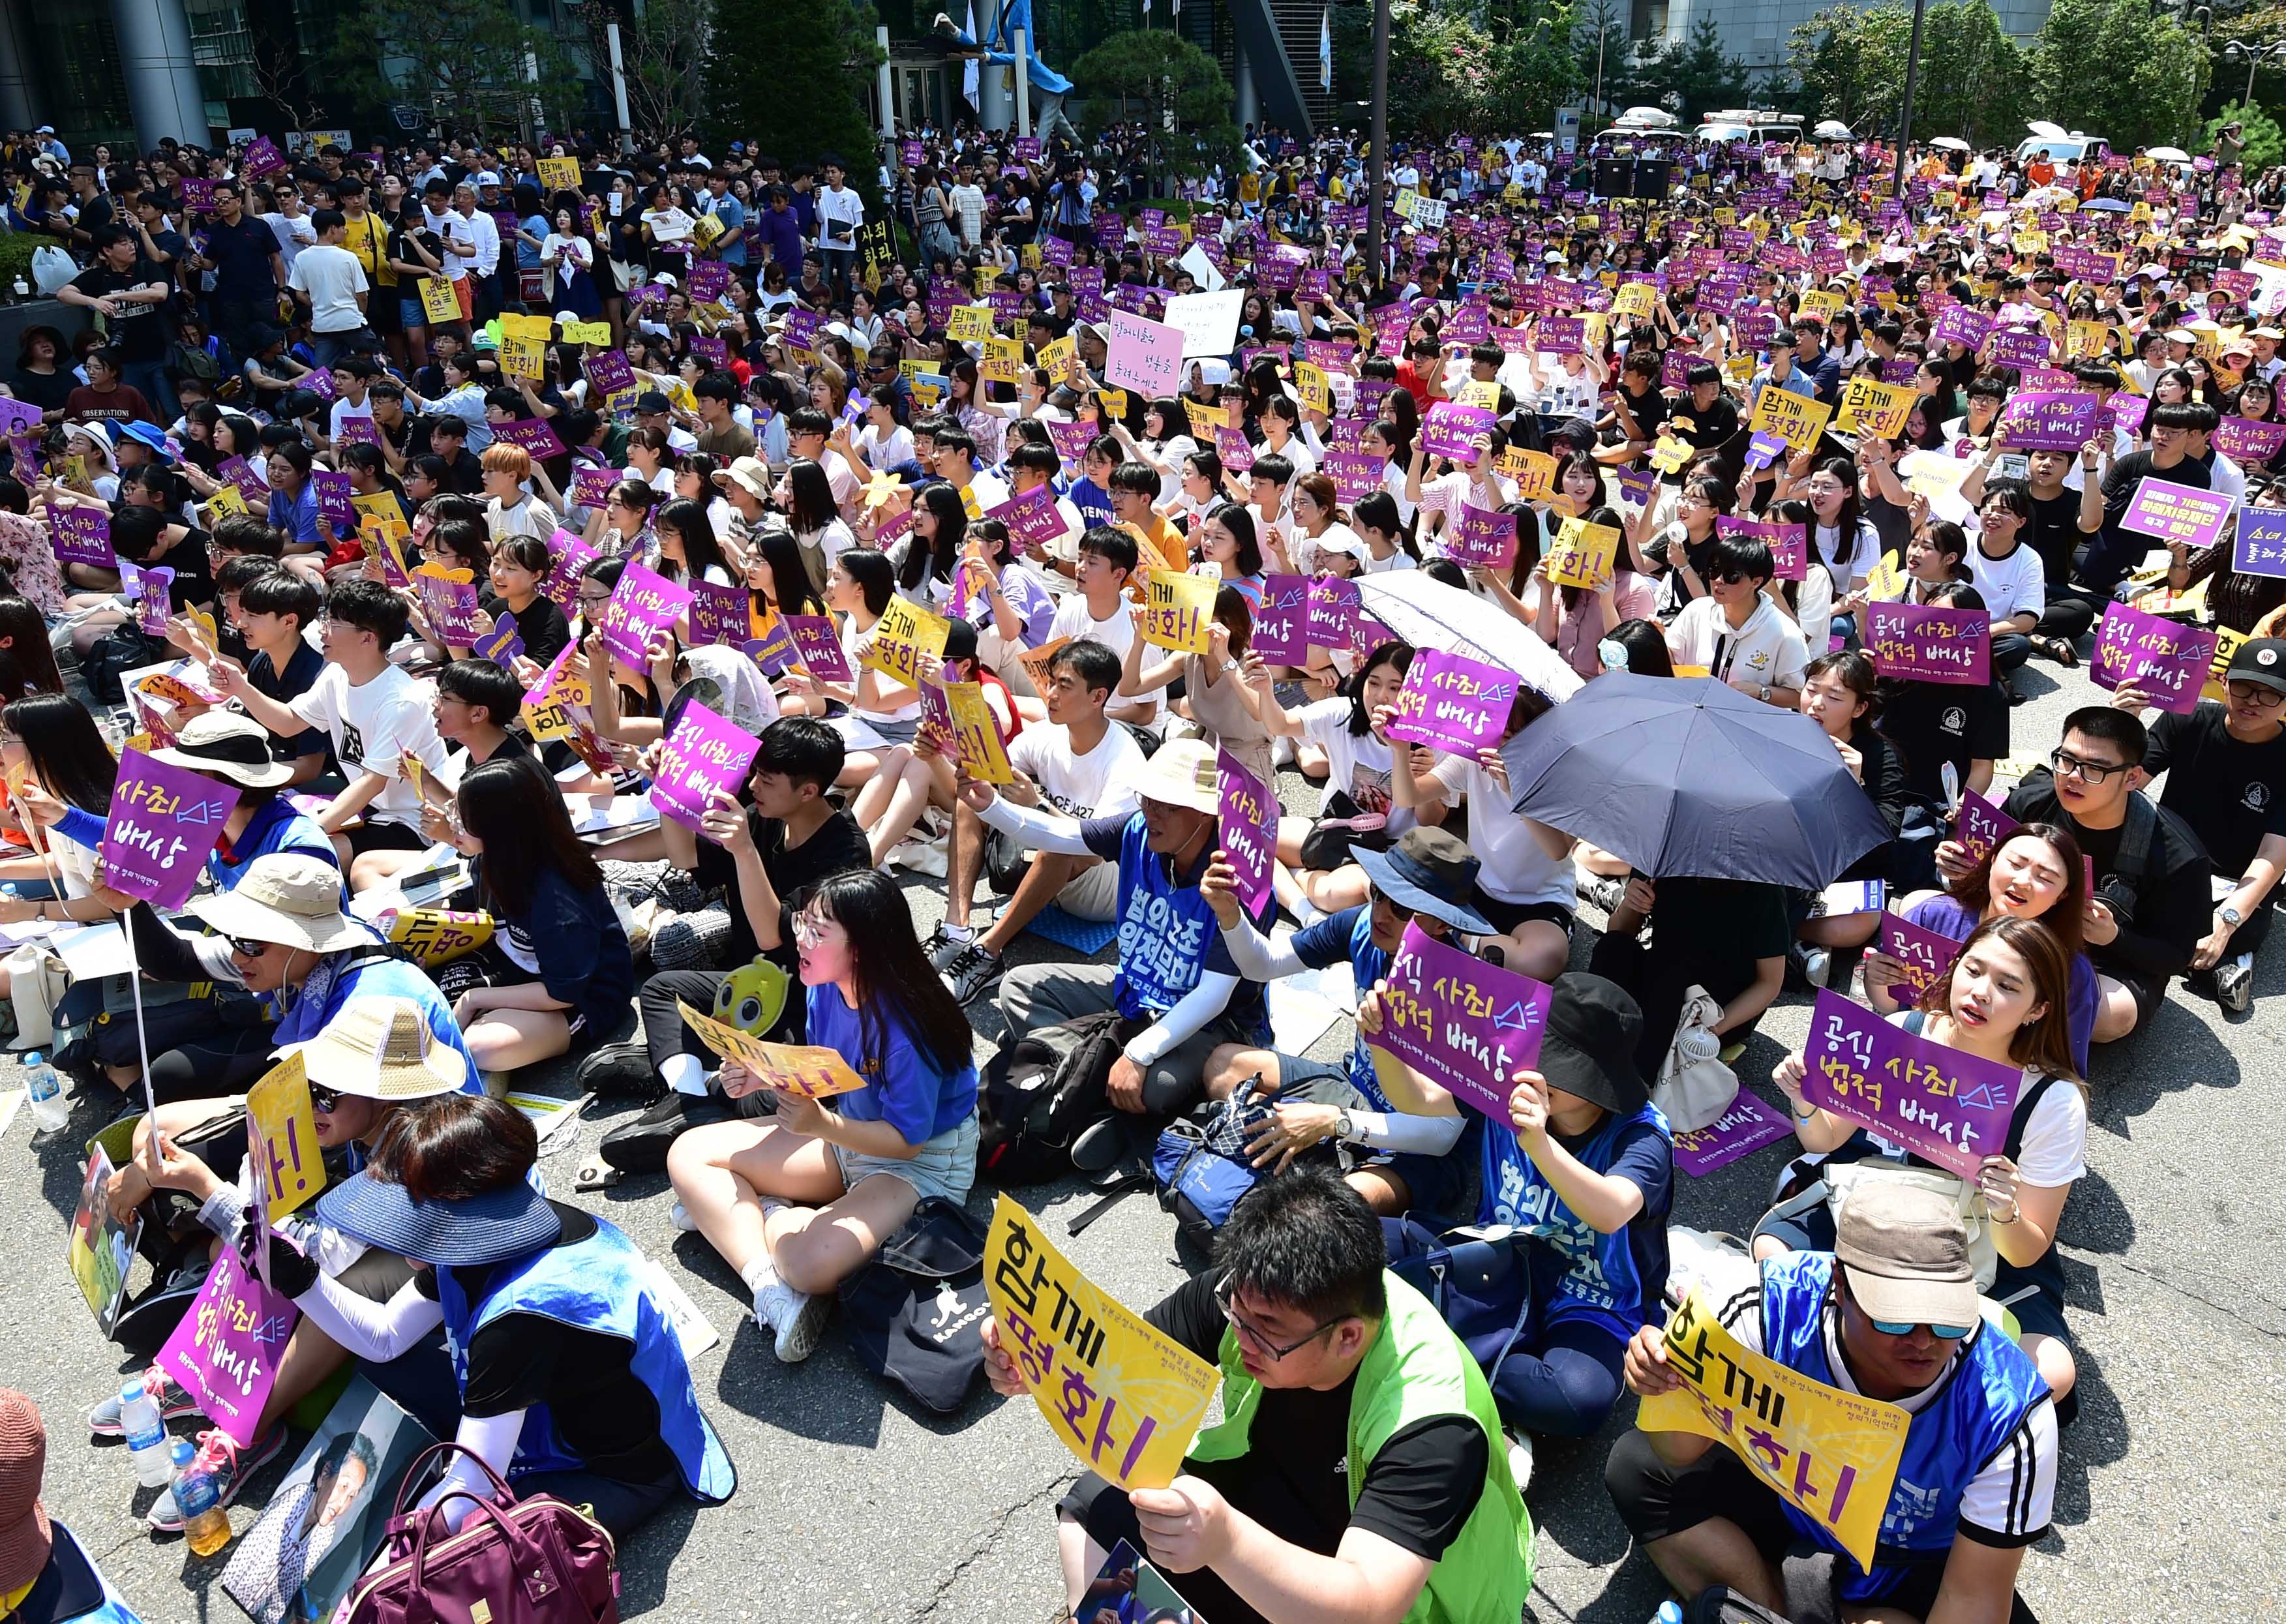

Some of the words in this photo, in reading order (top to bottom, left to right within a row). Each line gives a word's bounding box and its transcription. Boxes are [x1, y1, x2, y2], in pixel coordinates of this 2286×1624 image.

[541, 163, 562, 174] 함께
[862, 220, 886, 245] 사죄
[1618, 286, 1638, 298] 함께
[1700, 284, 1710, 293] 공식
[1698, 294, 1710, 303] 법적
[1712, 298, 1728, 307] 배상
[1805, 293, 1828, 305] 함께
[954, 308, 977, 323] 함께
[1947, 310, 1962, 321] 공식
[1963, 316, 1981, 329] 사죄
[955, 323, 986, 339] 평화!
[1541, 323, 1552, 333] 공식
[1556, 323, 1572, 332] 사죄
[1944, 320, 1962, 332] 법적
[1964, 327, 1981, 340] 배상
[504, 338, 526, 354] 함께
[1540, 334, 1556, 343] 법적
[1559, 335, 1578, 344] 배상
[2000, 336, 2014, 348] 공식
[985, 342, 1007, 359] 함께
[1039, 346, 1064, 368] 함께
[1999, 348, 2016, 359] 법적
[2020, 352, 2041, 363] 배상
[506, 356, 537, 376] 평화!
[2025, 374, 2043, 385] 공식
[1762, 391, 1803, 416] 함께
[1848, 383, 1891, 408] 함께
[1432, 408, 1451, 424] 공식
[1451, 412, 1475, 425] 사죄
[2011, 402, 2034, 416] 공식
[2041, 404, 2072, 416] 사죄
[1336, 427, 1351, 439] 공식
[1428, 427, 1448, 441] 법적
[1452, 430, 1477, 446] 배상
[1764, 414, 1817, 448] 평화!
[2011, 417, 2040, 435] 법적
[2048, 421, 2083, 436] 배상
[2219, 424, 2240, 437] 공식
[2244, 429, 2269, 440] 사죄
[1336, 440, 1355, 453] 법적
[2218, 437, 2243, 451] 법적
[2247, 443, 2275, 455] 배상
[1326, 460, 1343, 475] 공식
[1346, 464, 1367, 474] 사죄
[1493, 453, 1527, 469] 함께
[1353, 479, 1379, 490] 배상
[1011, 503, 1034, 521] 사죄
[1081, 506, 1123, 524] TENNIS
[2139, 500, 2216, 526] 화해치유재단
[53, 513, 72, 532] 공식
[74, 518, 94, 529] 사죄
[1022, 513, 1053, 532] 배상
[1466, 520, 1492, 535] 사죄
[2169, 520, 2197, 537] 해산
[58, 530, 81, 547] 법적
[82, 537, 106, 552] 배상
[1469, 541, 1505, 556] 배상
[618, 574, 636, 604] 공식
[635, 589, 663, 616] 사죄
[694, 590, 711, 609] 공식
[715, 596, 734, 610] 사죄
[1308, 588, 1338, 603] 사죄
[607, 599, 627, 630] 법적
[628, 616, 658, 646] 배상
[696, 611, 717, 629] 법적
[723, 617, 744, 635] 배상
[879, 602, 916, 637] 함께
[1310, 610, 1344, 632] 배상
[1874, 614, 1905, 639] 공식
[1914, 622, 1956, 639] 사죄
[795, 627, 819, 642] 사죄
[2105, 616, 2133, 645] 공식
[2137, 633, 2177, 656] 사죄
[804, 646, 837, 665] 배상
[1874, 639, 1915, 663] 법적
[1926, 644, 1975, 667] 배상
[2100, 643, 2129, 674] 법적
[2137, 662, 2189, 690] 배상
[1432, 672, 1481, 696] 사죄
[1397, 689, 1426, 717] 법적
[1436, 700, 1491, 735] 배상
[671, 715, 702, 751] 공식
[700, 737, 734, 765] 사죄
[658, 745, 687, 785] 법적
[687, 769, 723, 809] 배상
[117, 780, 180, 815] 사죄
[1230, 791, 1263, 826] 사죄
[1968, 807, 1997, 845] 공식
[113, 820, 188, 869] 배상
[1227, 827, 1267, 877] 배상
[1893, 931, 1934, 969] 공식
[1392, 940, 1422, 993] 공식
[1434, 976, 1494, 1017] 사죄
[1386, 984, 1433, 1041] 법적
[1446, 1023, 1513, 1081] 배상
[1824, 1015, 1874, 1069] 공식
[1885, 1058, 1957, 1096] 사죄
[1388, 1031, 1422, 1065] 일본군성노예제
[1422, 1051, 1451, 1075] 문제해결을
[1452, 1070, 1464, 1082] 위한
[1466, 1077, 1499, 1102] 정의기억연대
[1820, 1055, 1882, 1111] 법적
[1899, 1098, 1980, 1153] 배상
[1827, 1096, 1868, 1124] 일본군성노예제
[1873, 1119, 1904, 1139] 문제해결을
[1908, 1135, 1921, 1145] 위한
[1924, 1143, 1965, 1167] 정의기억연대
[993, 1218, 1105, 1368] 함께
[1101, 1302, 1151, 1344] 일본군성노예제
[1153, 1340, 1192, 1370] 문제해결을
[1195, 1370, 1211, 1382] 위한
[1662, 1299, 1784, 1428] 함께
[1160, 1358, 1208, 1391] 정의기억연대
[1004, 1305, 1158, 1482] 평화!
[1773, 1370, 1832, 1401] 일본군성노예제
[1835, 1397, 1879, 1417] 문제해결을
[1884, 1409, 1901, 1421] 위한
[1846, 1411, 1899, 1430] 정의기억연대
